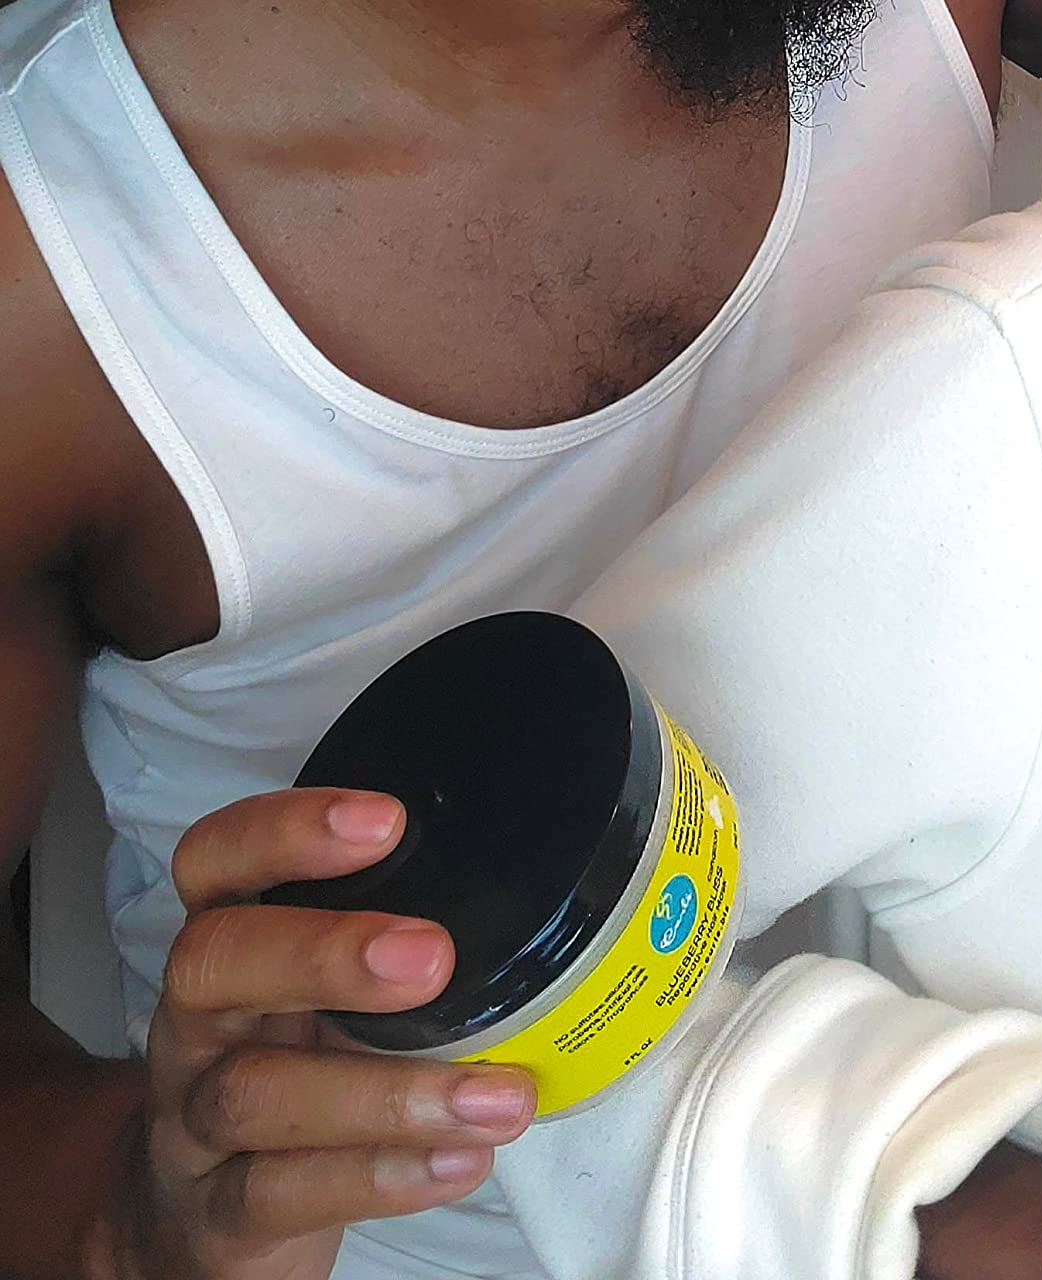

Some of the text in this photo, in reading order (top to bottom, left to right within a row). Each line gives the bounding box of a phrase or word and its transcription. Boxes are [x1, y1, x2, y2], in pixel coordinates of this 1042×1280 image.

[655, 865, 723, 1007] BLUEBERRY BLISS
[666, 880, 727, 1006] Reparative Hair Mask
[553, 1033, 569, 1046] NO
